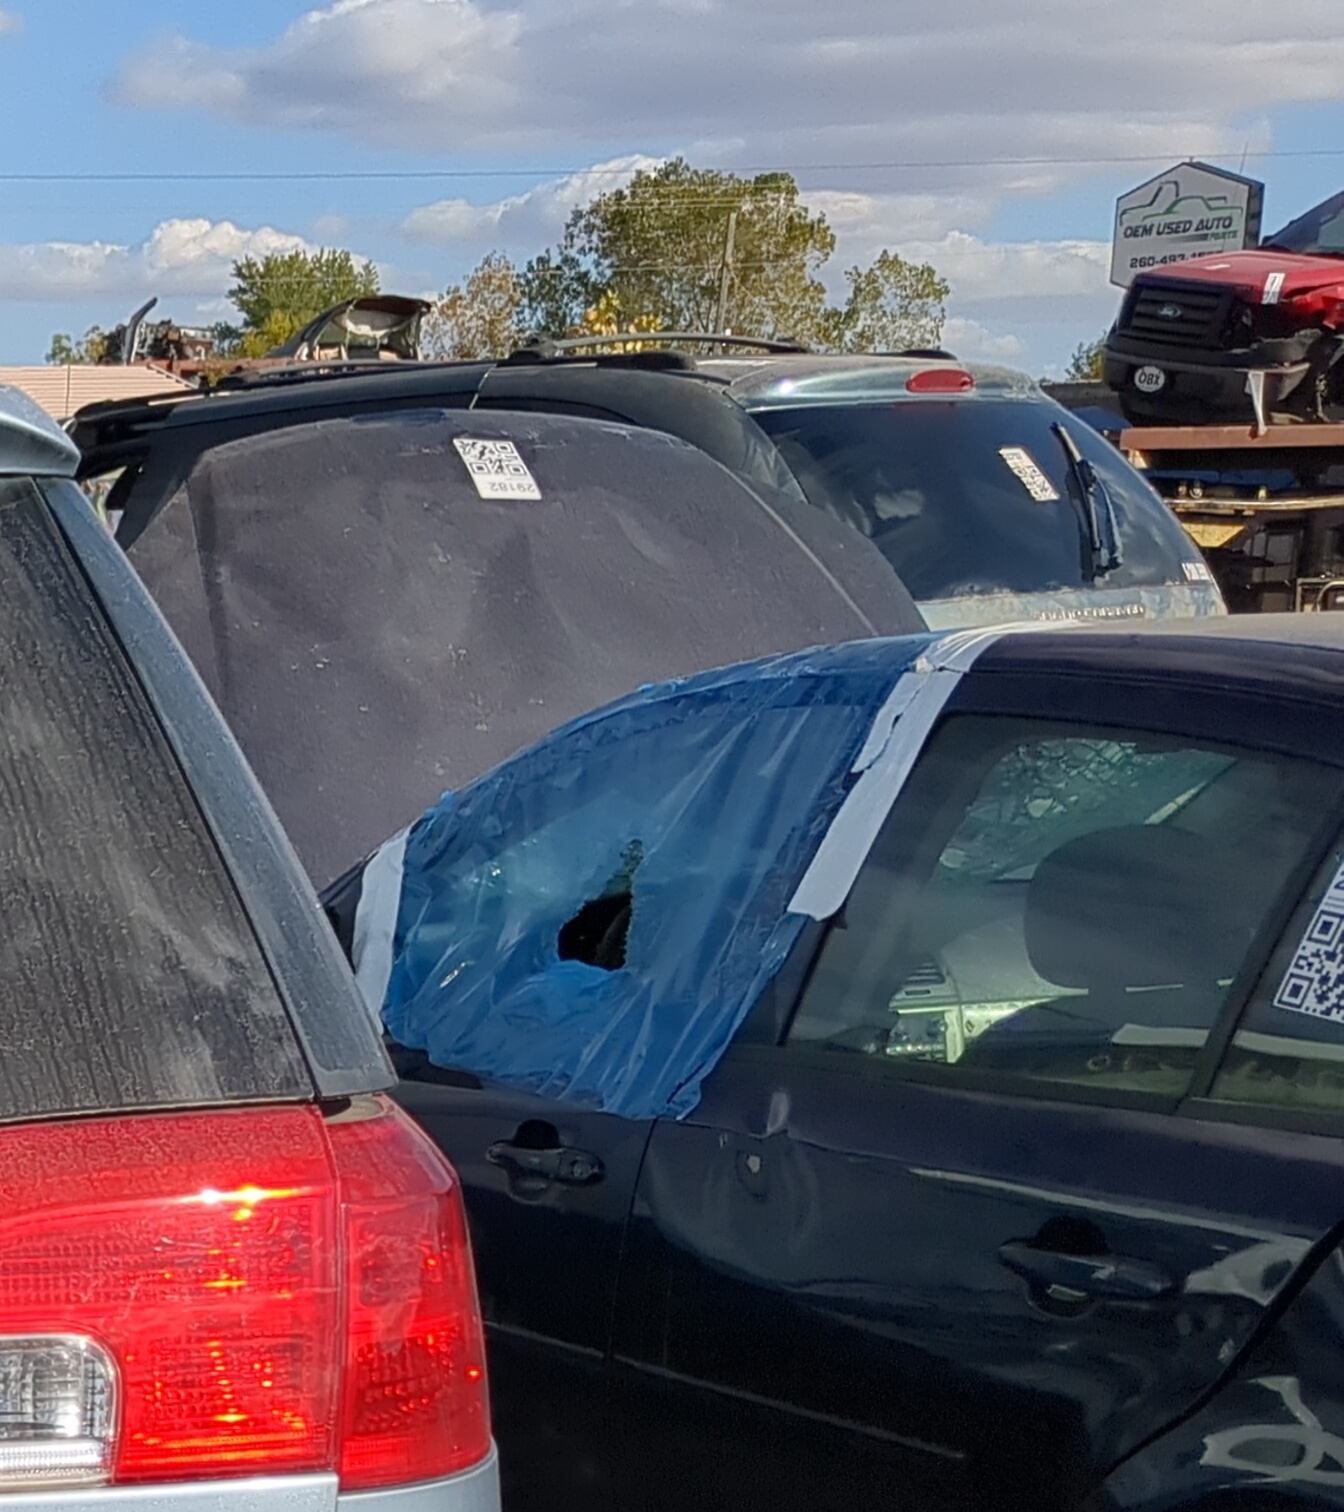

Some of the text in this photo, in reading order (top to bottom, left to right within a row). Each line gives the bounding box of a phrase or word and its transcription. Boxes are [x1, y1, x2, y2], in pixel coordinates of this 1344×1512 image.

[1123, 216, 1234, 239] OEM USED AUTO
[1138, 371, 1162, 386] OBX
